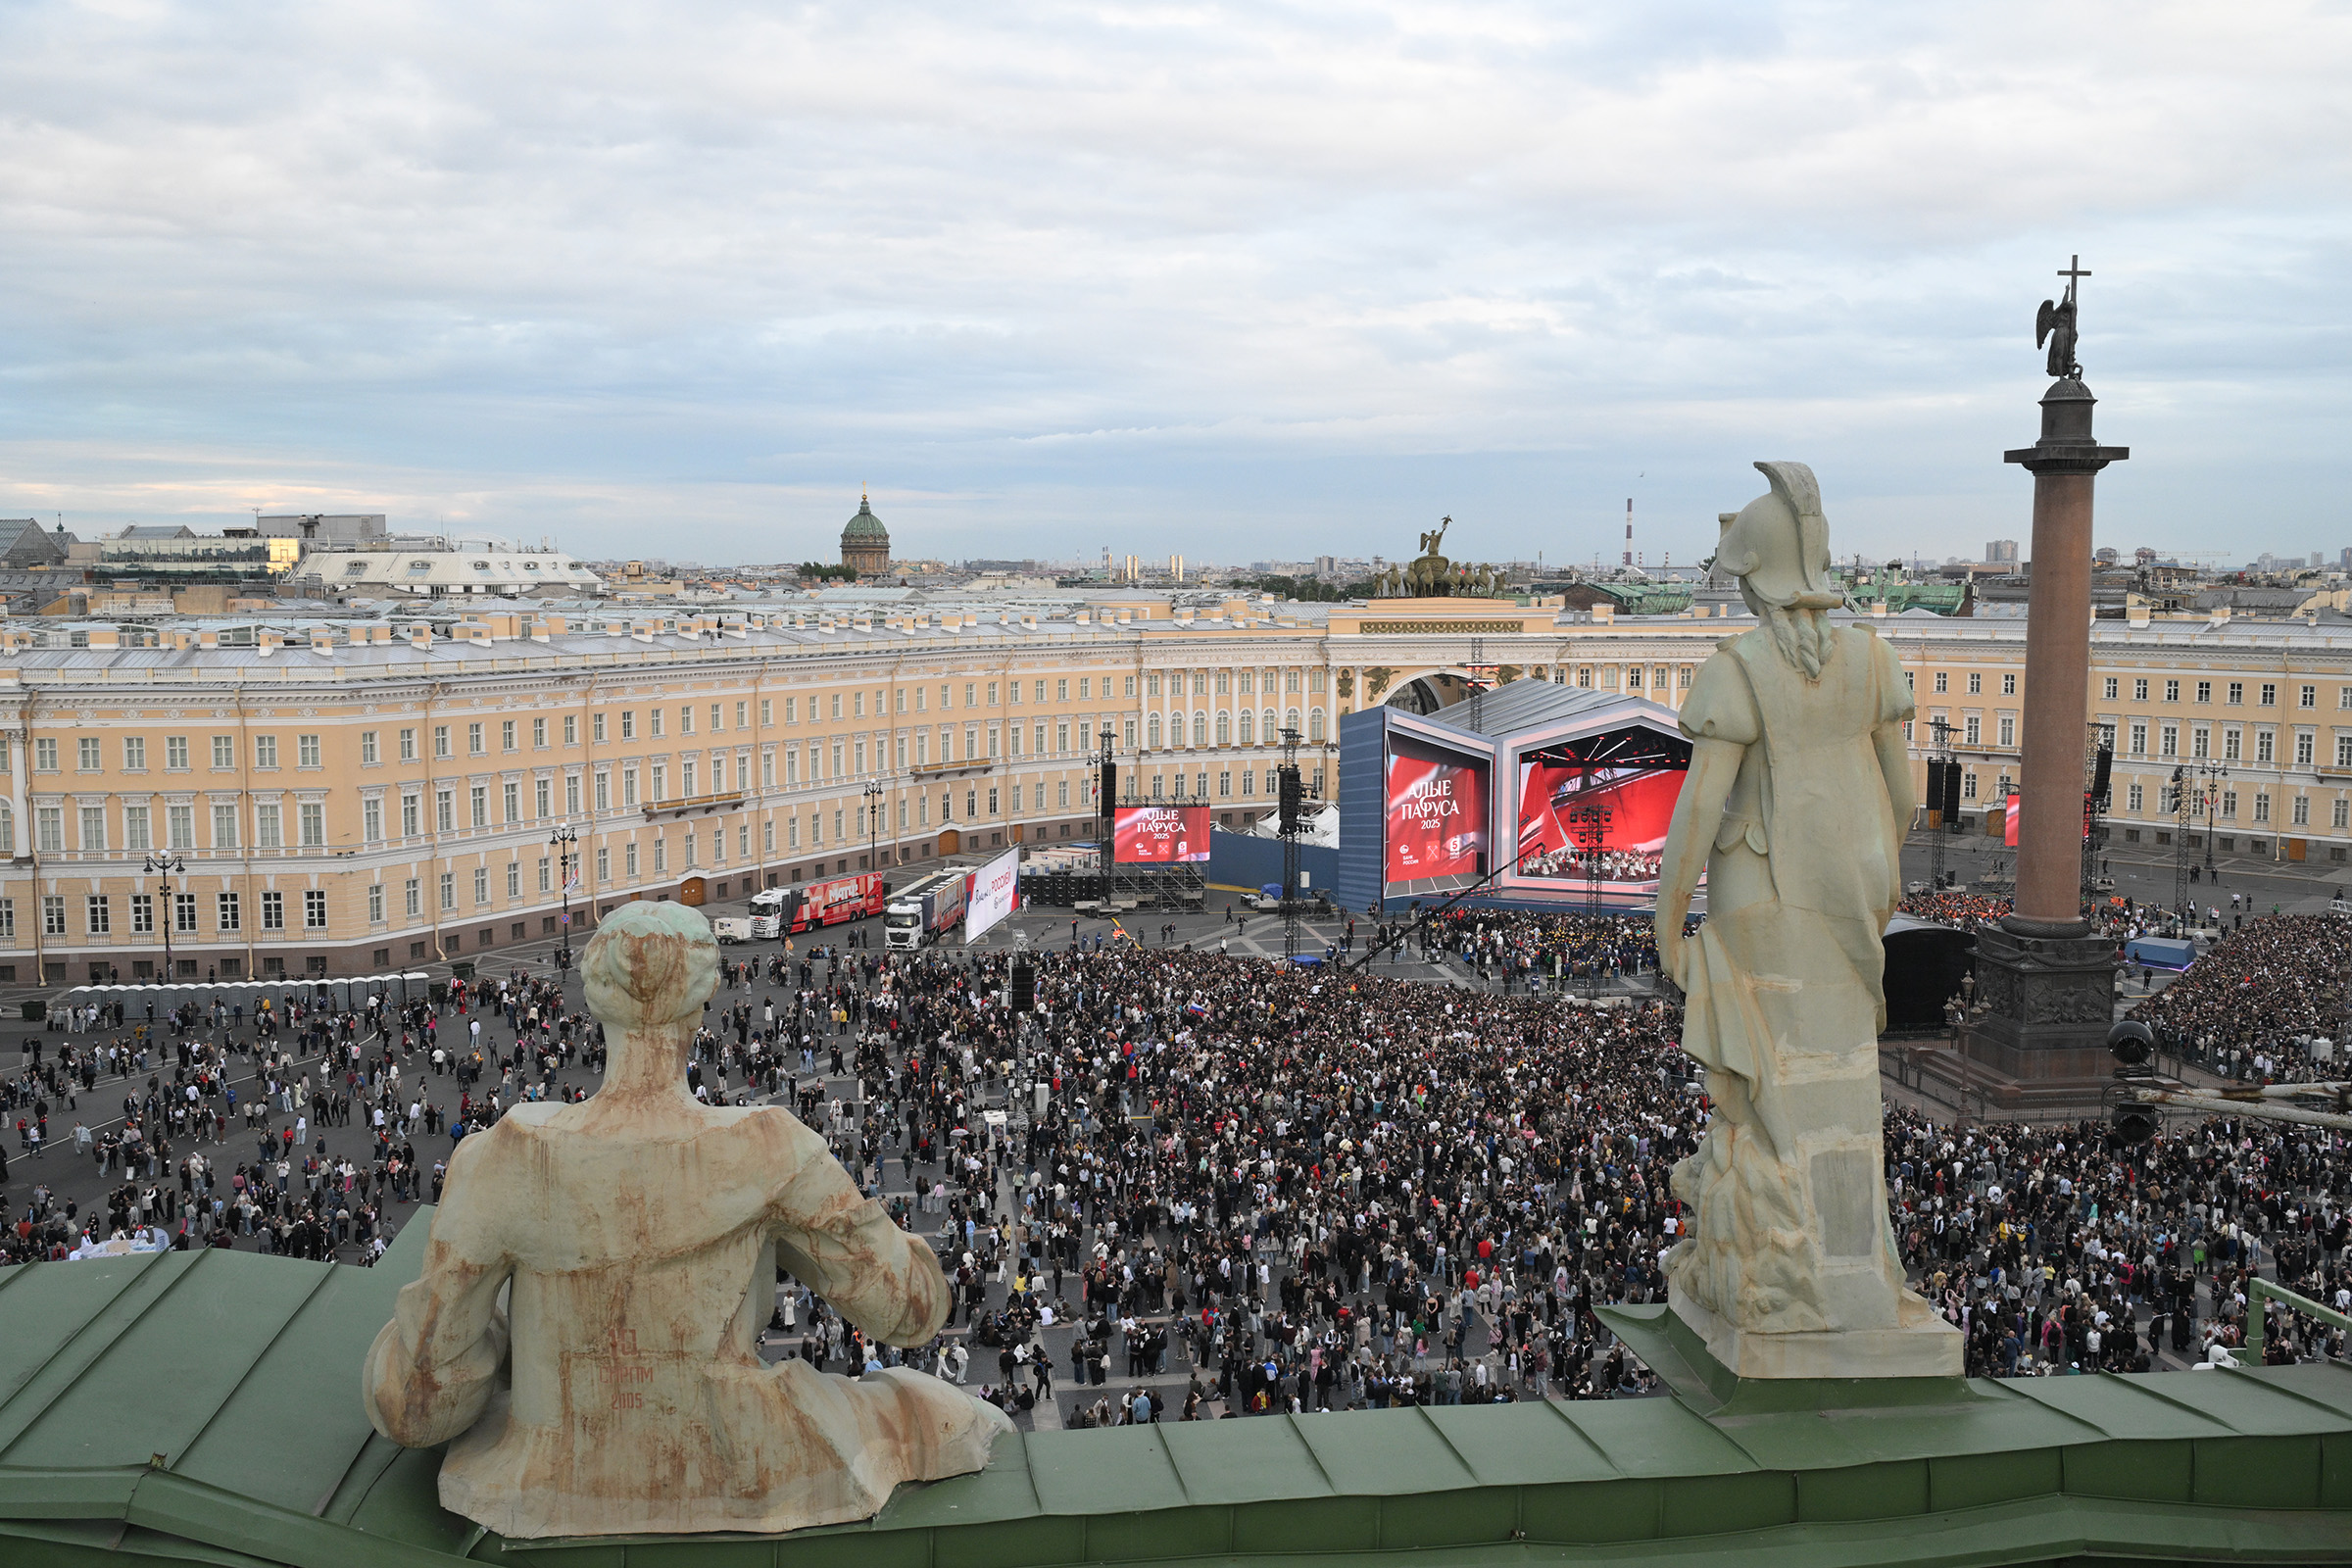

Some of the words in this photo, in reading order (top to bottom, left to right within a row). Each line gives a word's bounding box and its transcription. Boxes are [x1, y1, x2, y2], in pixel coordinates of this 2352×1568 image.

[1407, 779, 1452, 799] АЛЫЕ
[1142, 809, 1179, 820] АЛЫЕ
[1401, 799, 1460, 820] ПАРУСА
[1137, 821, 1187, 833] ПАРУСА
[1421, 818, 1441, 830] 2025
[1452, 840, 1458, 849] 5
[609, 1328, 637, 1358] 10
[612, 1393, 643, 1410] 2005
